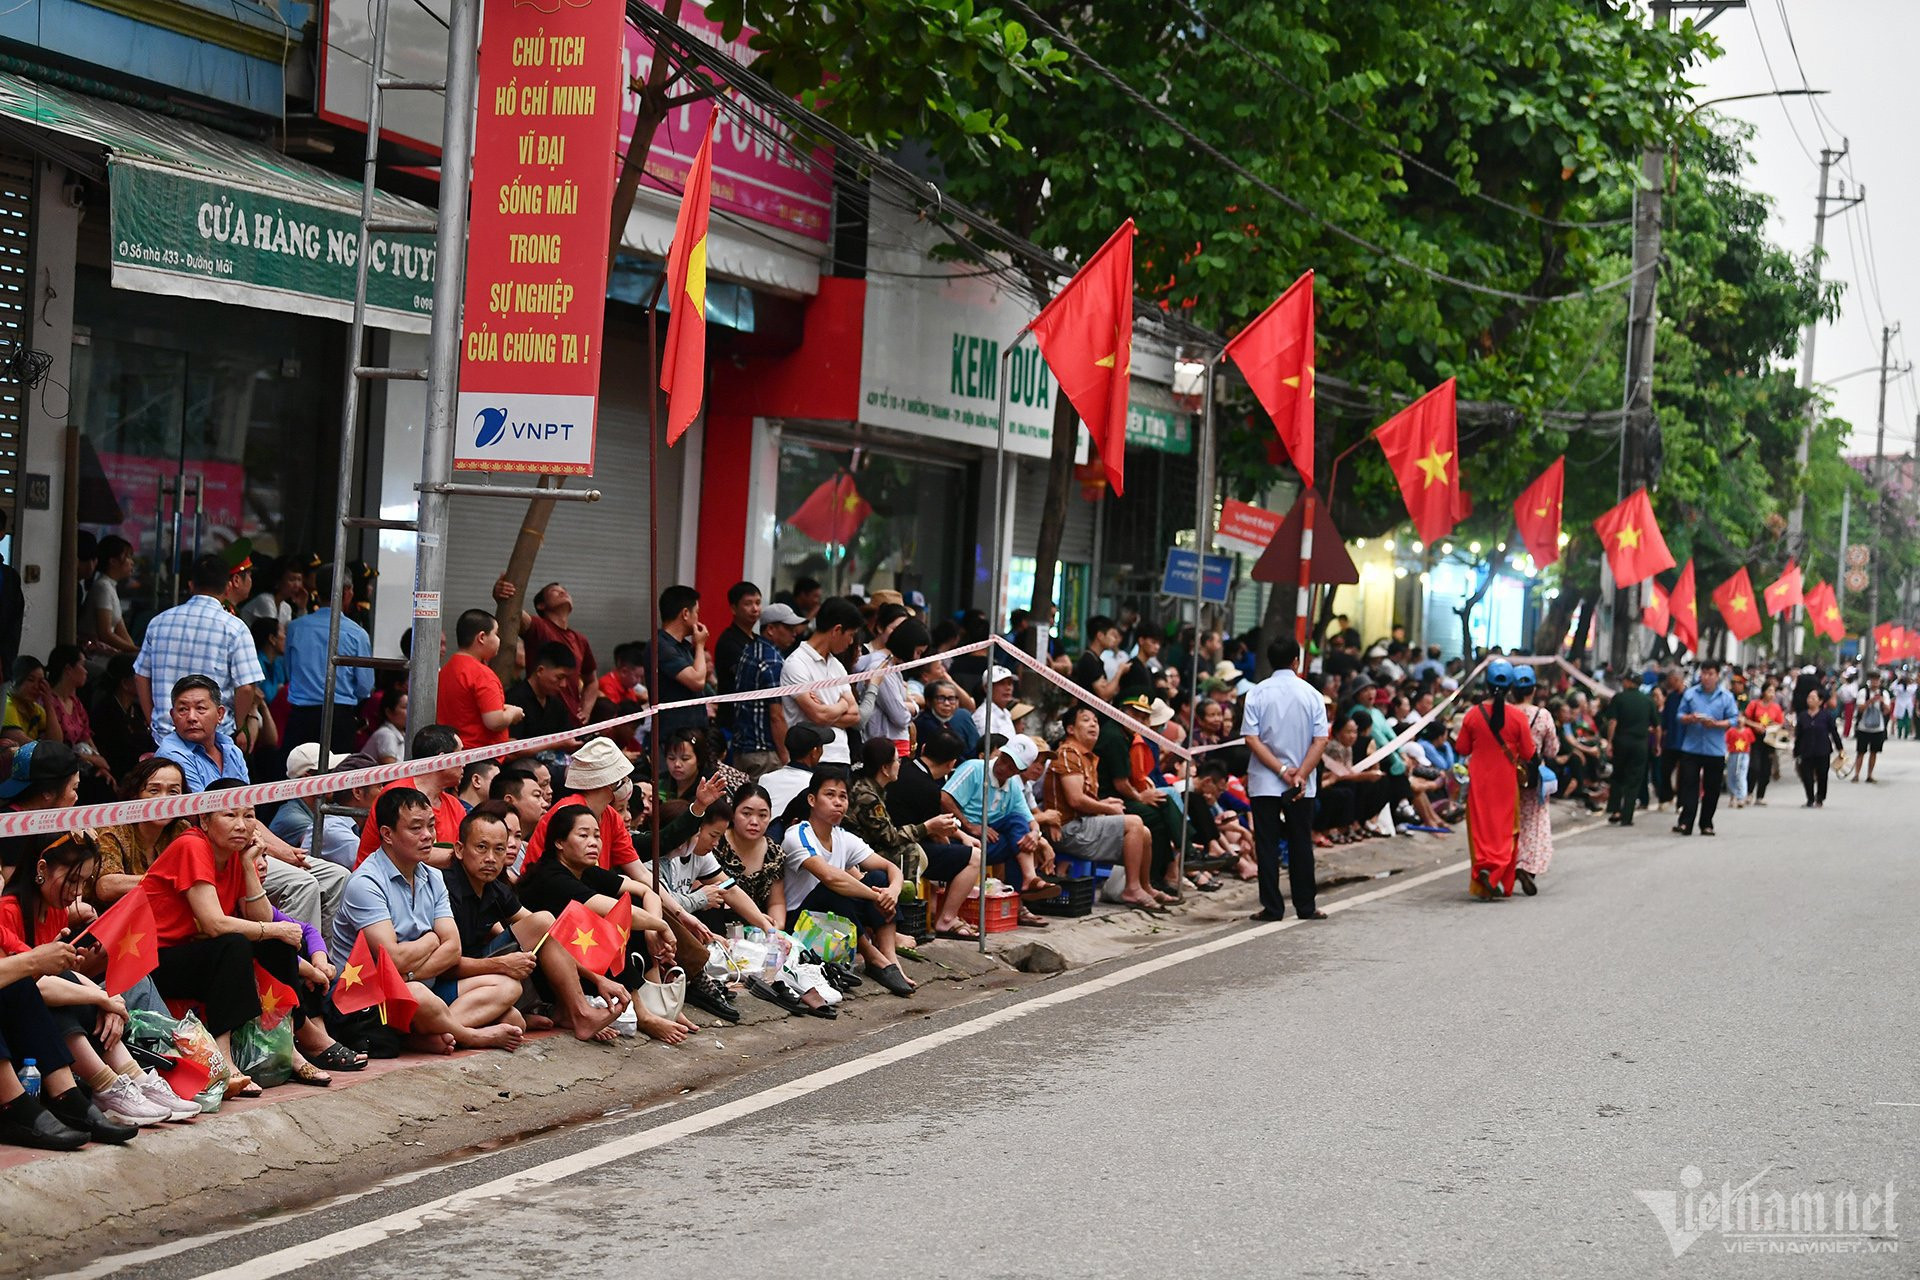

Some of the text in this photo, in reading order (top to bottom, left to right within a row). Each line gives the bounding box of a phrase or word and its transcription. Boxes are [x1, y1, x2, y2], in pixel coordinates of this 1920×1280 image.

[512, 27, 586, 72] CHỦ TỊCH
[495, 77, 596, 116] HỒ CHÍ MINH
[519, 130, 565, 171] VĨ ĐẠI
[499, 174, 578, 215] SỐNG MÃI
[129, 242, 142, 259] Số
[143, 246, 160, 261] nhà
[162, 249, 179, 265] 433
[186, 253, 213, 274] Đường
[198, 195, 437, 282] CỬA HÀNG NGC TUY
[509, 234, 561, 264] TRONG
[489, 278, 574, 319] SỰ NGHIỆP
[467, 322, 498, 361] CỦA
[503, 327, 557, 363] CHÚNG
[561, 334, 578, 363] TA
[951, 332, 998, 401] KEM
[511, 422, 574, 441] VNPT
